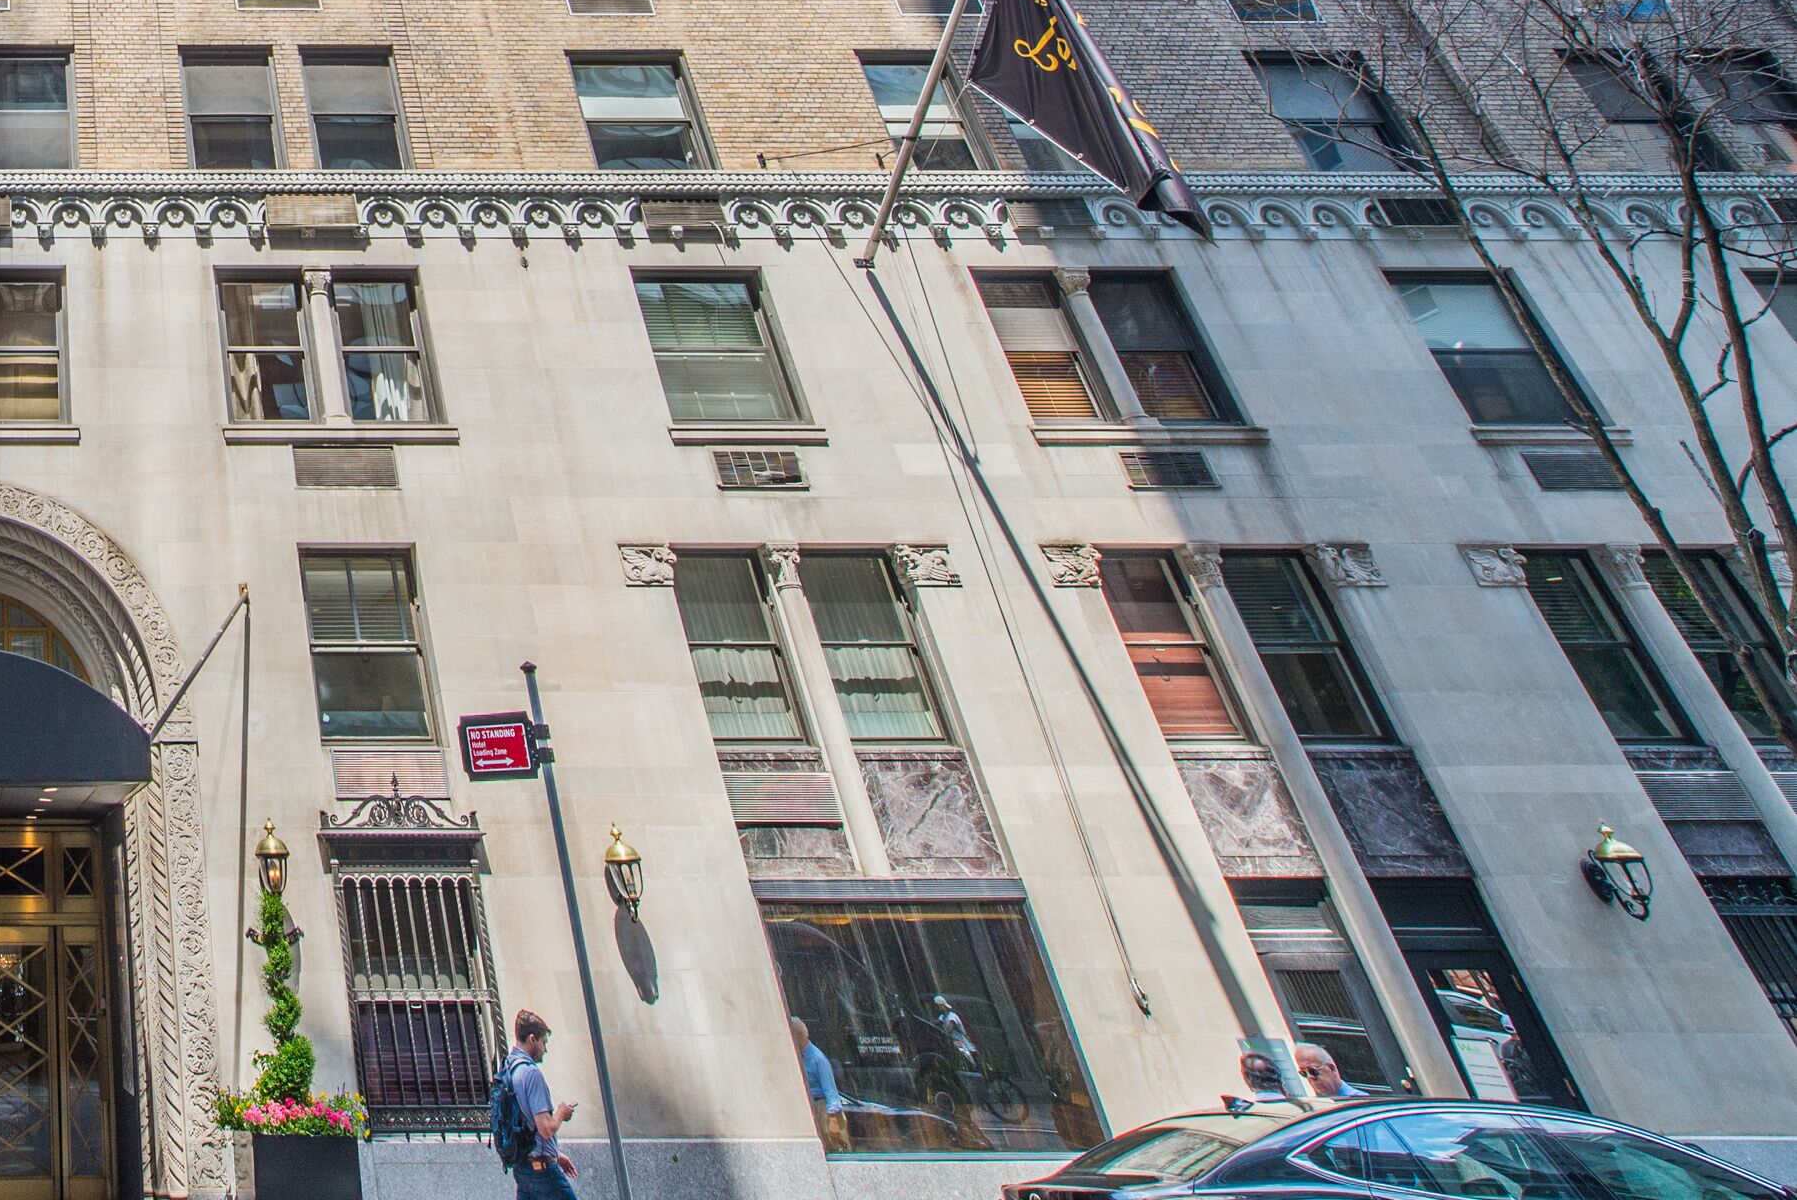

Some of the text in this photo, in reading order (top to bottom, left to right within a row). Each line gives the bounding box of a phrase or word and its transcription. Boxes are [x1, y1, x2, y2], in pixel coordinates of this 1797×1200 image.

[470, 728, 516, 740] NO STANDING
[471, 741, 486, 749] Hotel
[473, 747, 508, 757] Loading Zone
